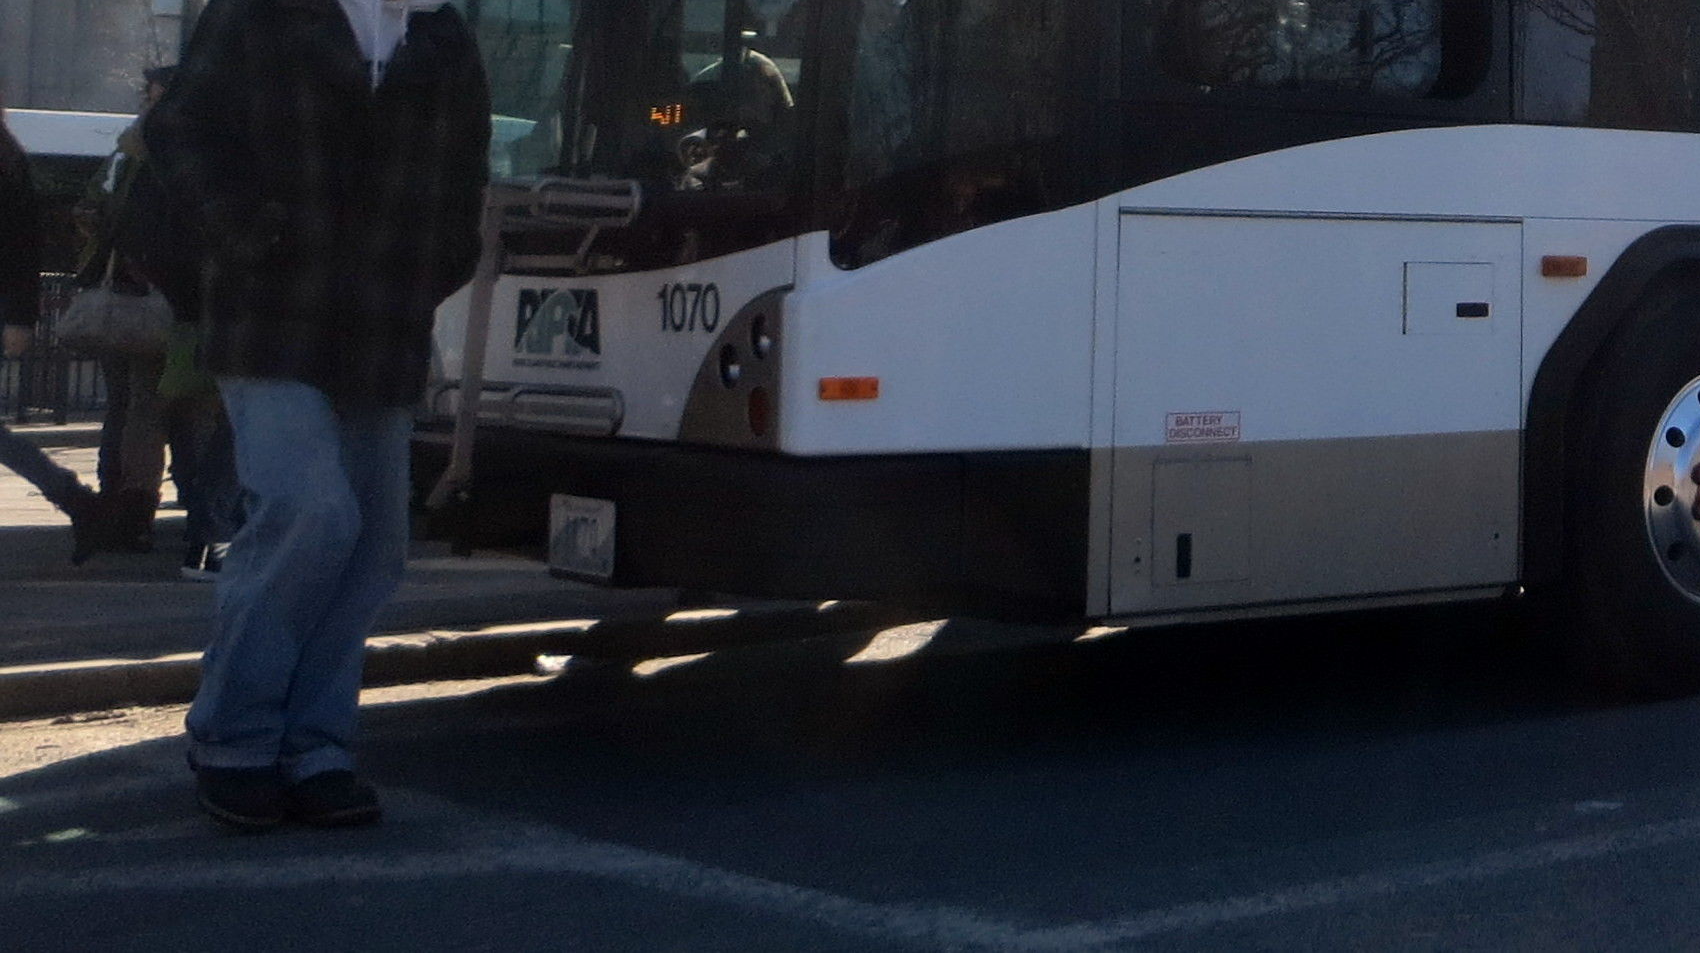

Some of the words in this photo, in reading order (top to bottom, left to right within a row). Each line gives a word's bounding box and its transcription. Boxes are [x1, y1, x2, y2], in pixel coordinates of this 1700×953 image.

[656, 281, 721, 334] 1070
[1175, 416, 1223, 426] BATTERY
[1168, 427, 1237, 438] DISCONNECT
